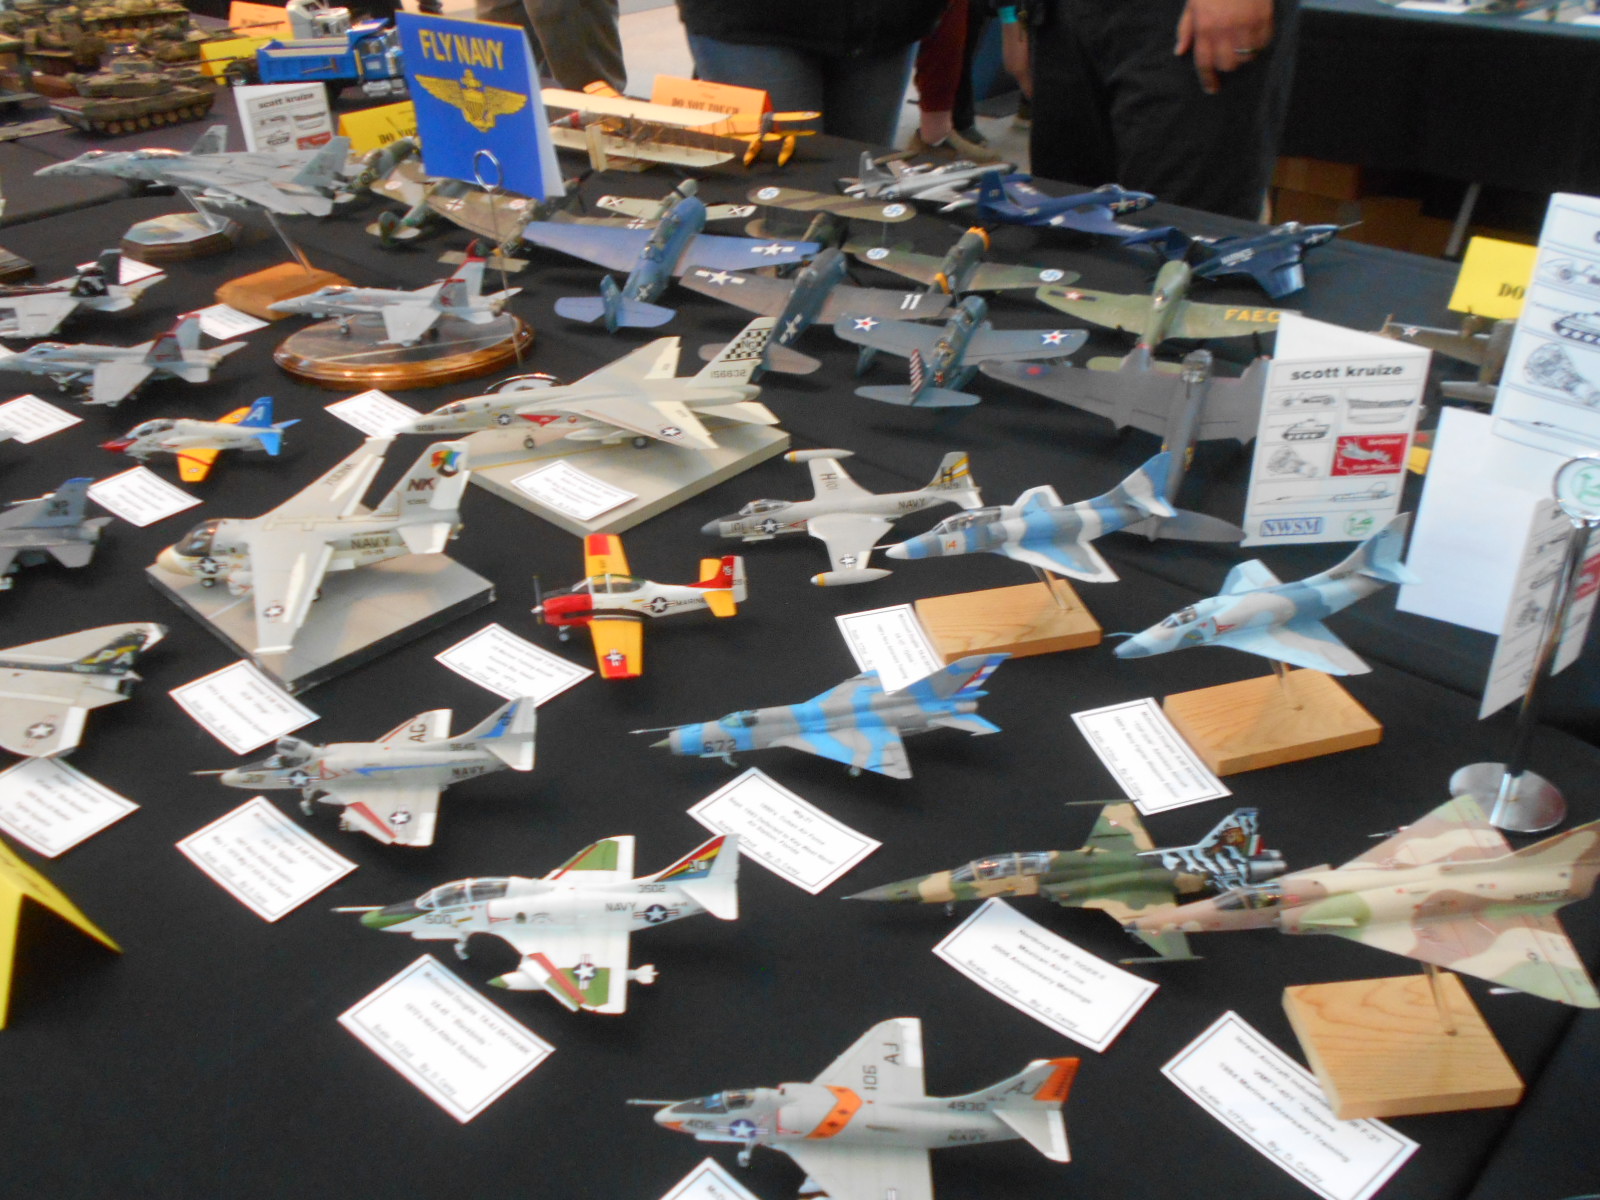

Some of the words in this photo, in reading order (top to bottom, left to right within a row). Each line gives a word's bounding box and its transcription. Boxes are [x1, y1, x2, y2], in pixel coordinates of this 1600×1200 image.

[418, 29, 453, 62] FLY
[453, 34, 505, 71] NAVY
[1497, 283, 1526, 300] DO
[900, 294, 923, 311] 11
[1290, 366, 1340, 381] scott
[1345, 364, 1404, 378] kruize
[406, 477, 437, 492] NK
[897, 497, 926, 511] NAVY
[1263, 518, 1322, 534] NWSM
[351, 536, 390, 549] NAVY
[452, 766, 485, 779] NAVY
[604, 901, 637, 913] NAVY
[862, 1064, 879, 1091] 106
